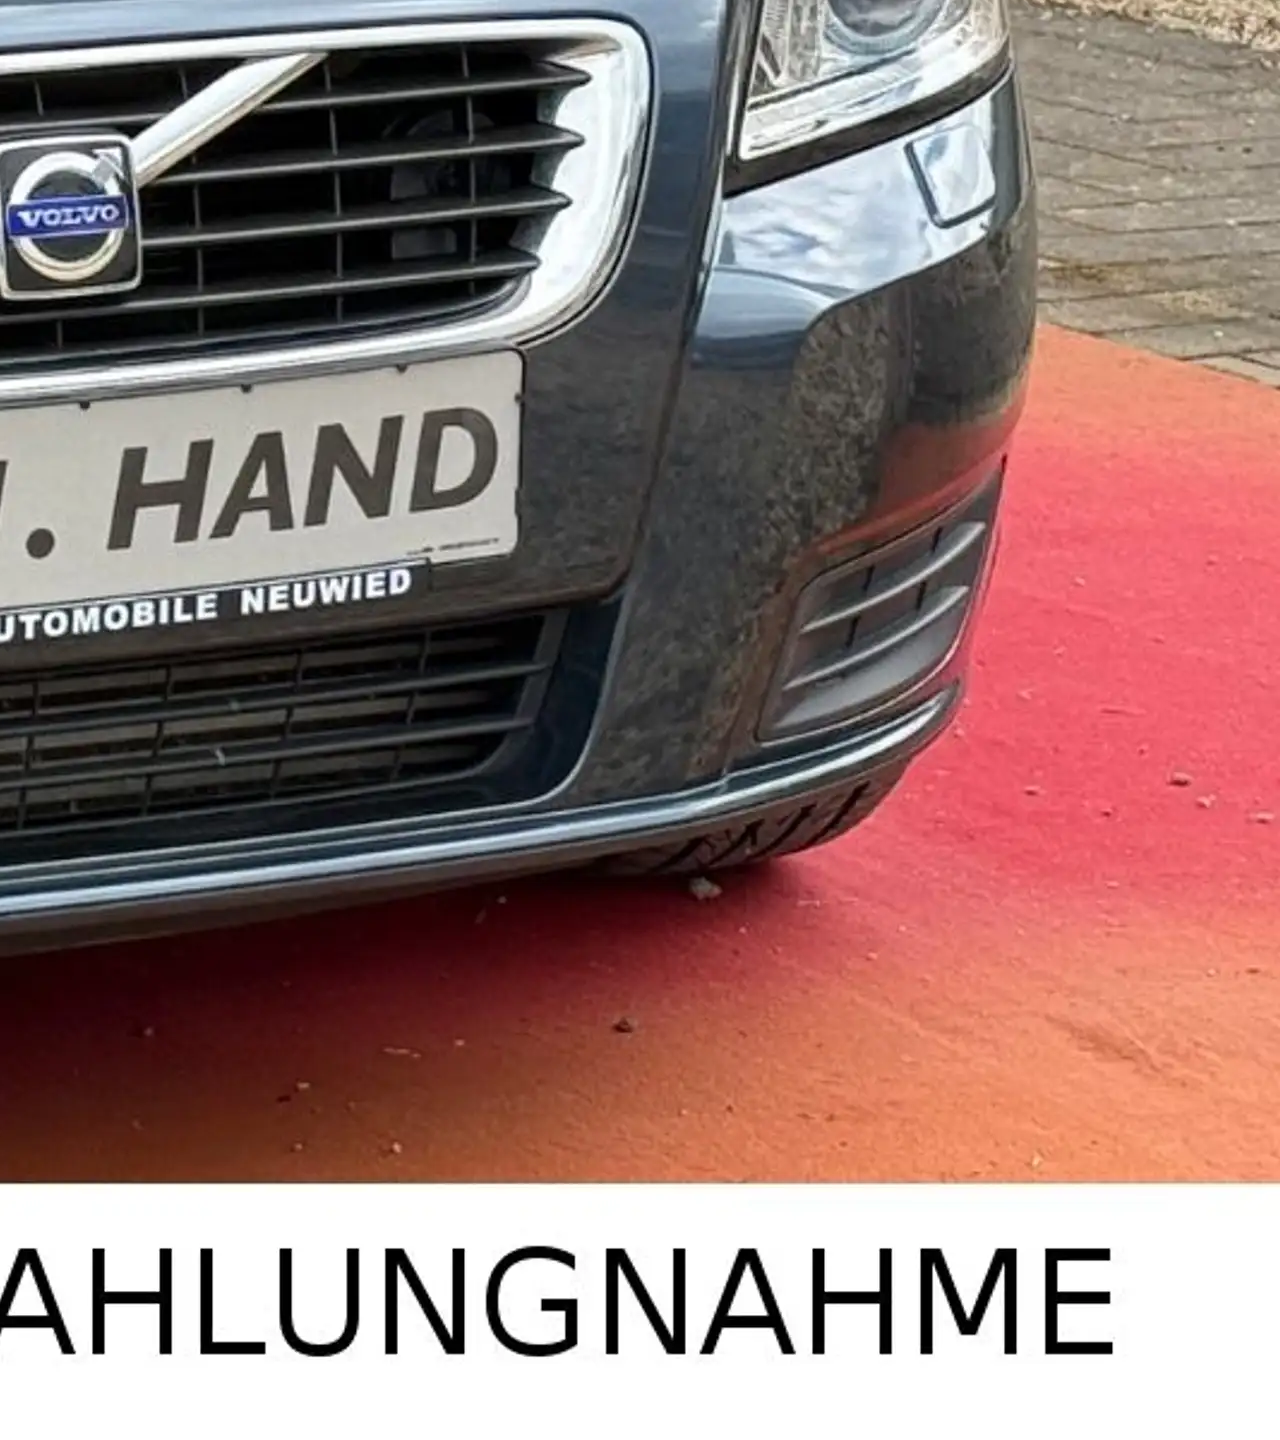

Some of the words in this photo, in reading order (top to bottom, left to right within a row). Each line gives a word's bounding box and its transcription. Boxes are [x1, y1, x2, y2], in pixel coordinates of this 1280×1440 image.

[17, 203, 120, 229] VOLVO
[106, 407, 499, 551] HAND
[240, 568, 412, 615] NEUWIED
